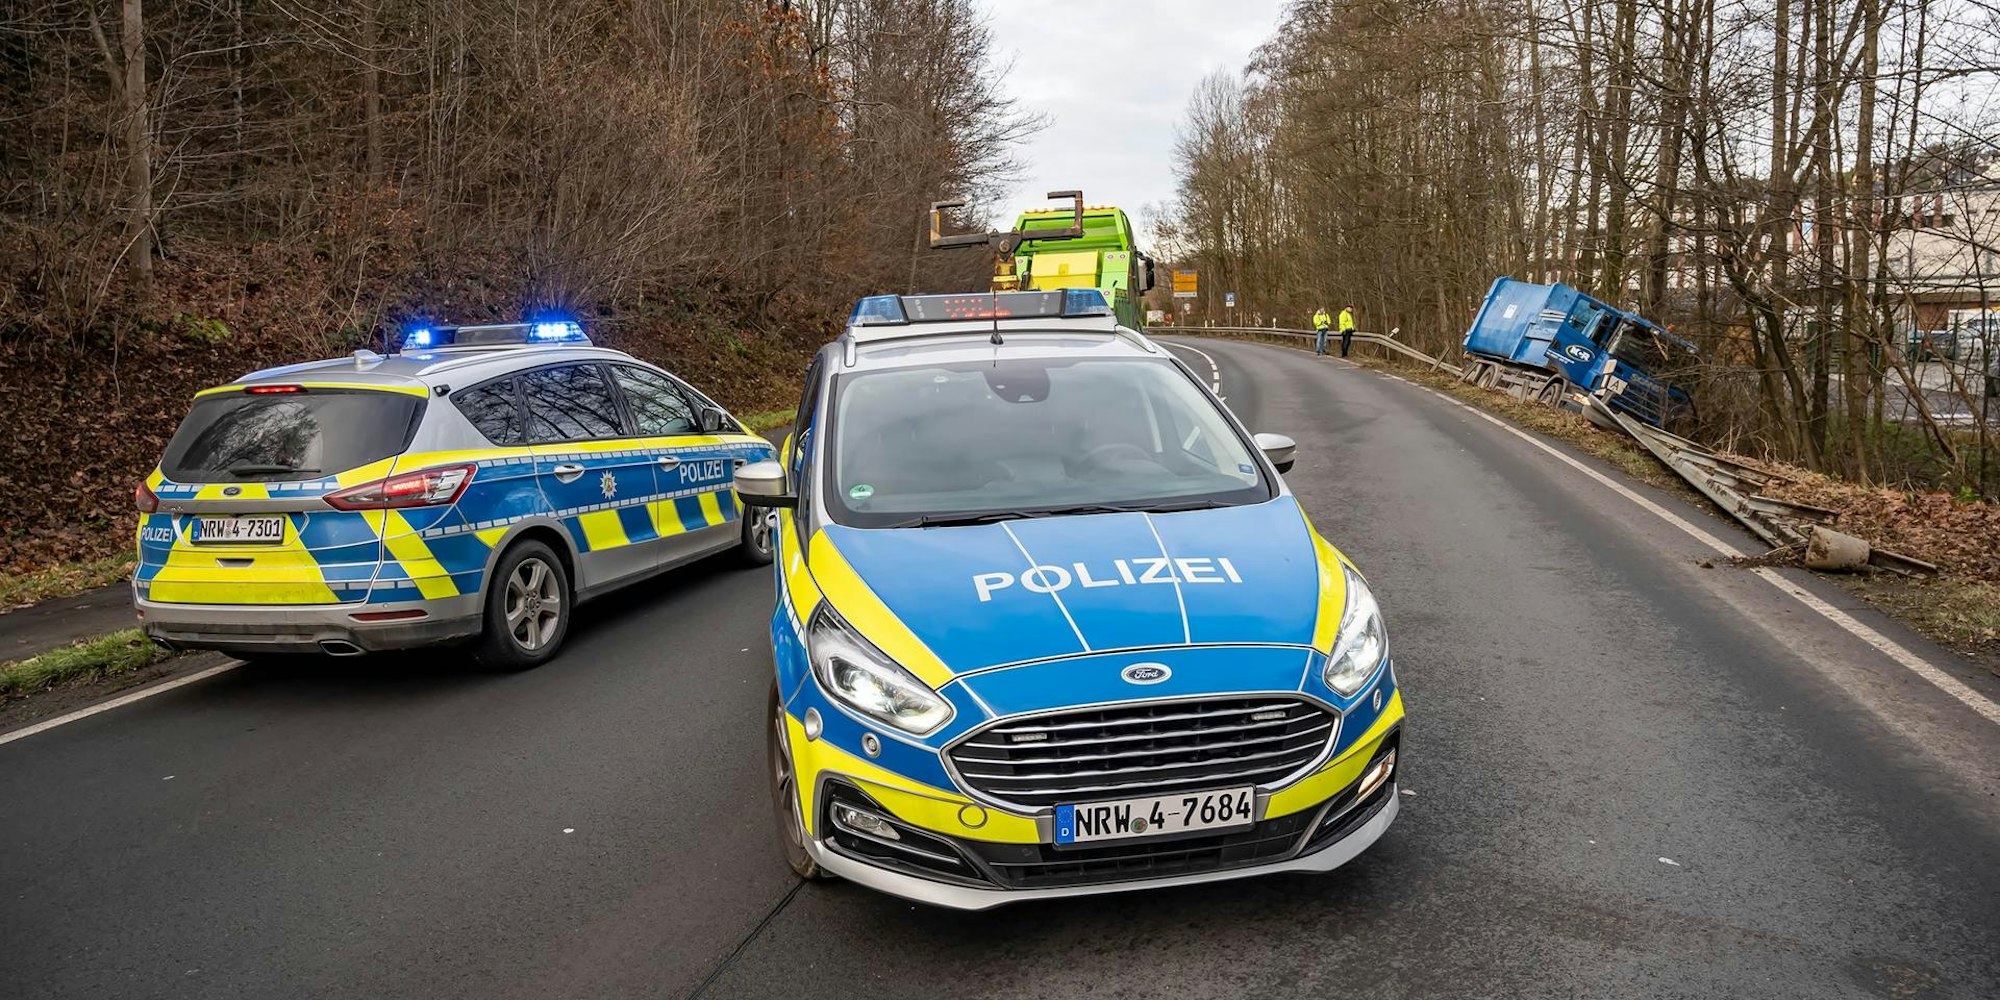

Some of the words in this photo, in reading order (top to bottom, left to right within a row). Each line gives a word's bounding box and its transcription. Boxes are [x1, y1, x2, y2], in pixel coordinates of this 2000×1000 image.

[1611, 380, 1620, 391] A
[679, 459, 725, 484] POLIZEI
[142, 527, 174, 542] POLIZEI
[200, 520, 226, 537] NRW
[232, 519, 281, 537] 4-7301
[973, 557, 1243, 602] POLIZEI
[1134, 668, 1158, 679] Ford
[1061, 828, 1069, 837] D
[1075, 804, 1131, 837] NRW
[1149, 792, 1251, 829] 4-7684
